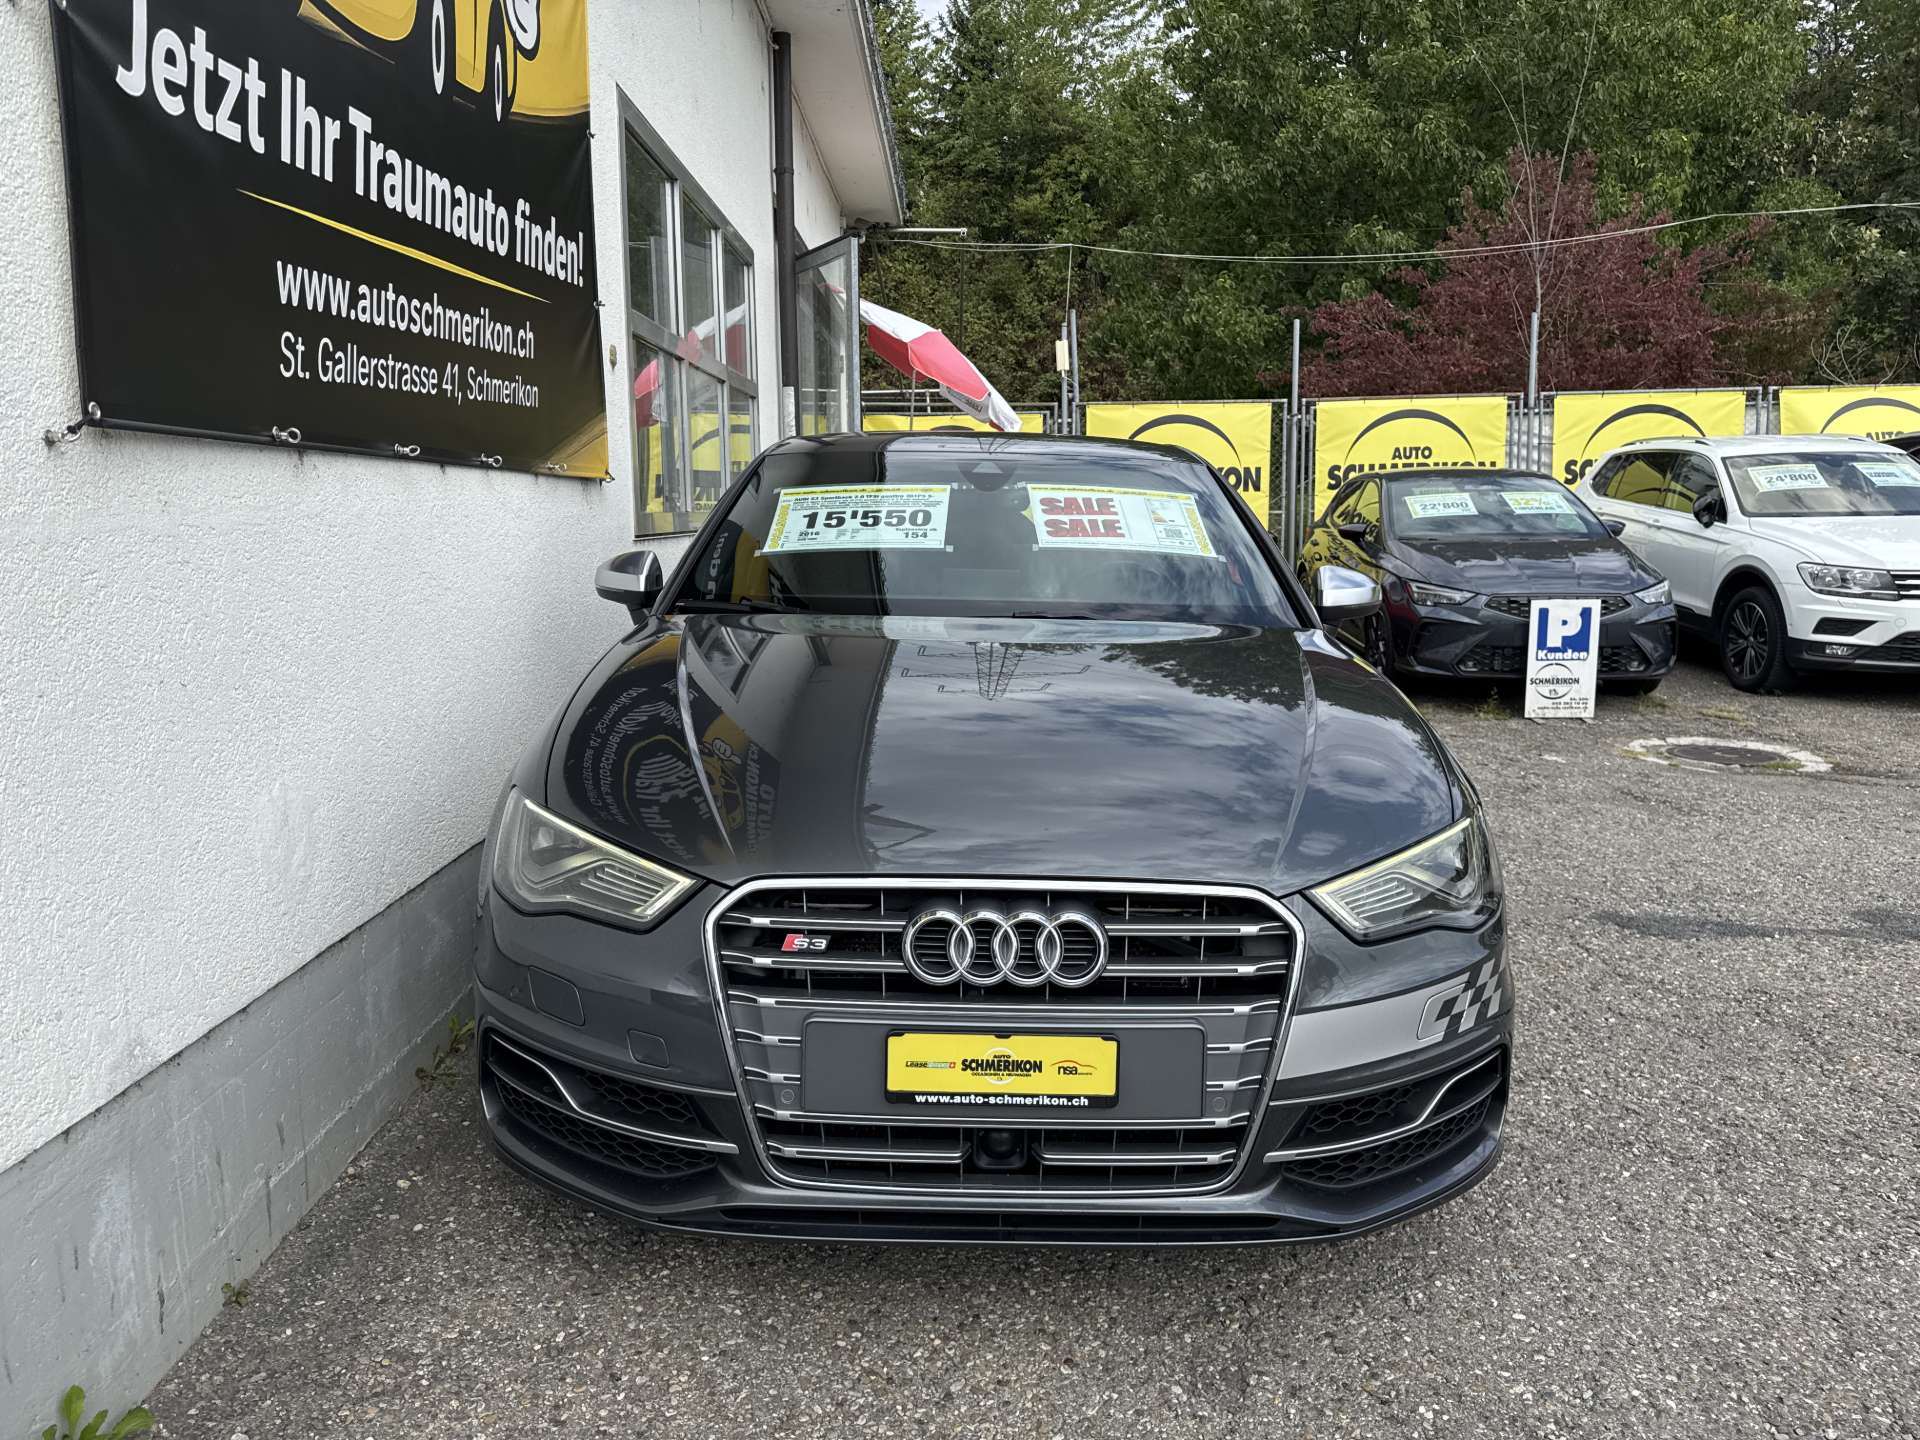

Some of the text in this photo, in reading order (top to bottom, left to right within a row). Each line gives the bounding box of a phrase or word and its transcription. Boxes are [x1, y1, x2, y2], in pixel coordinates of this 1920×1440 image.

[115, 0, 585, 287] Jetzt Ihr Traumauto finden!
[276, 259, 536, 360] www.autoschmerikon.ch
[279, 330, 540, 409] St. Gallerstrasse 41, Schmerikon
[1391, 446, 1433, 461] AUTO
[1764, 473, 1817, 485] 24'800
[1039, 496, 1119, 516] SALE
[1418, 500, 1469, 511] 22'800
[802, 508, 932, 530] 15'550
[903, 531, 929, 539] 154
[1044, 518, 1126, 538] SALE
[1537, 648, 1588, 660] Kunden
[1529, 676, 1580, 686] SCHMERIKON
[792, 937, 827, 950] S3
[961, 1058, 1043, 1073] SCHMERIKON
[1057, 1065, 1078, 1076] nsa
[914, 1093, 1089, 1106] www.auto-schmerikon.ch
